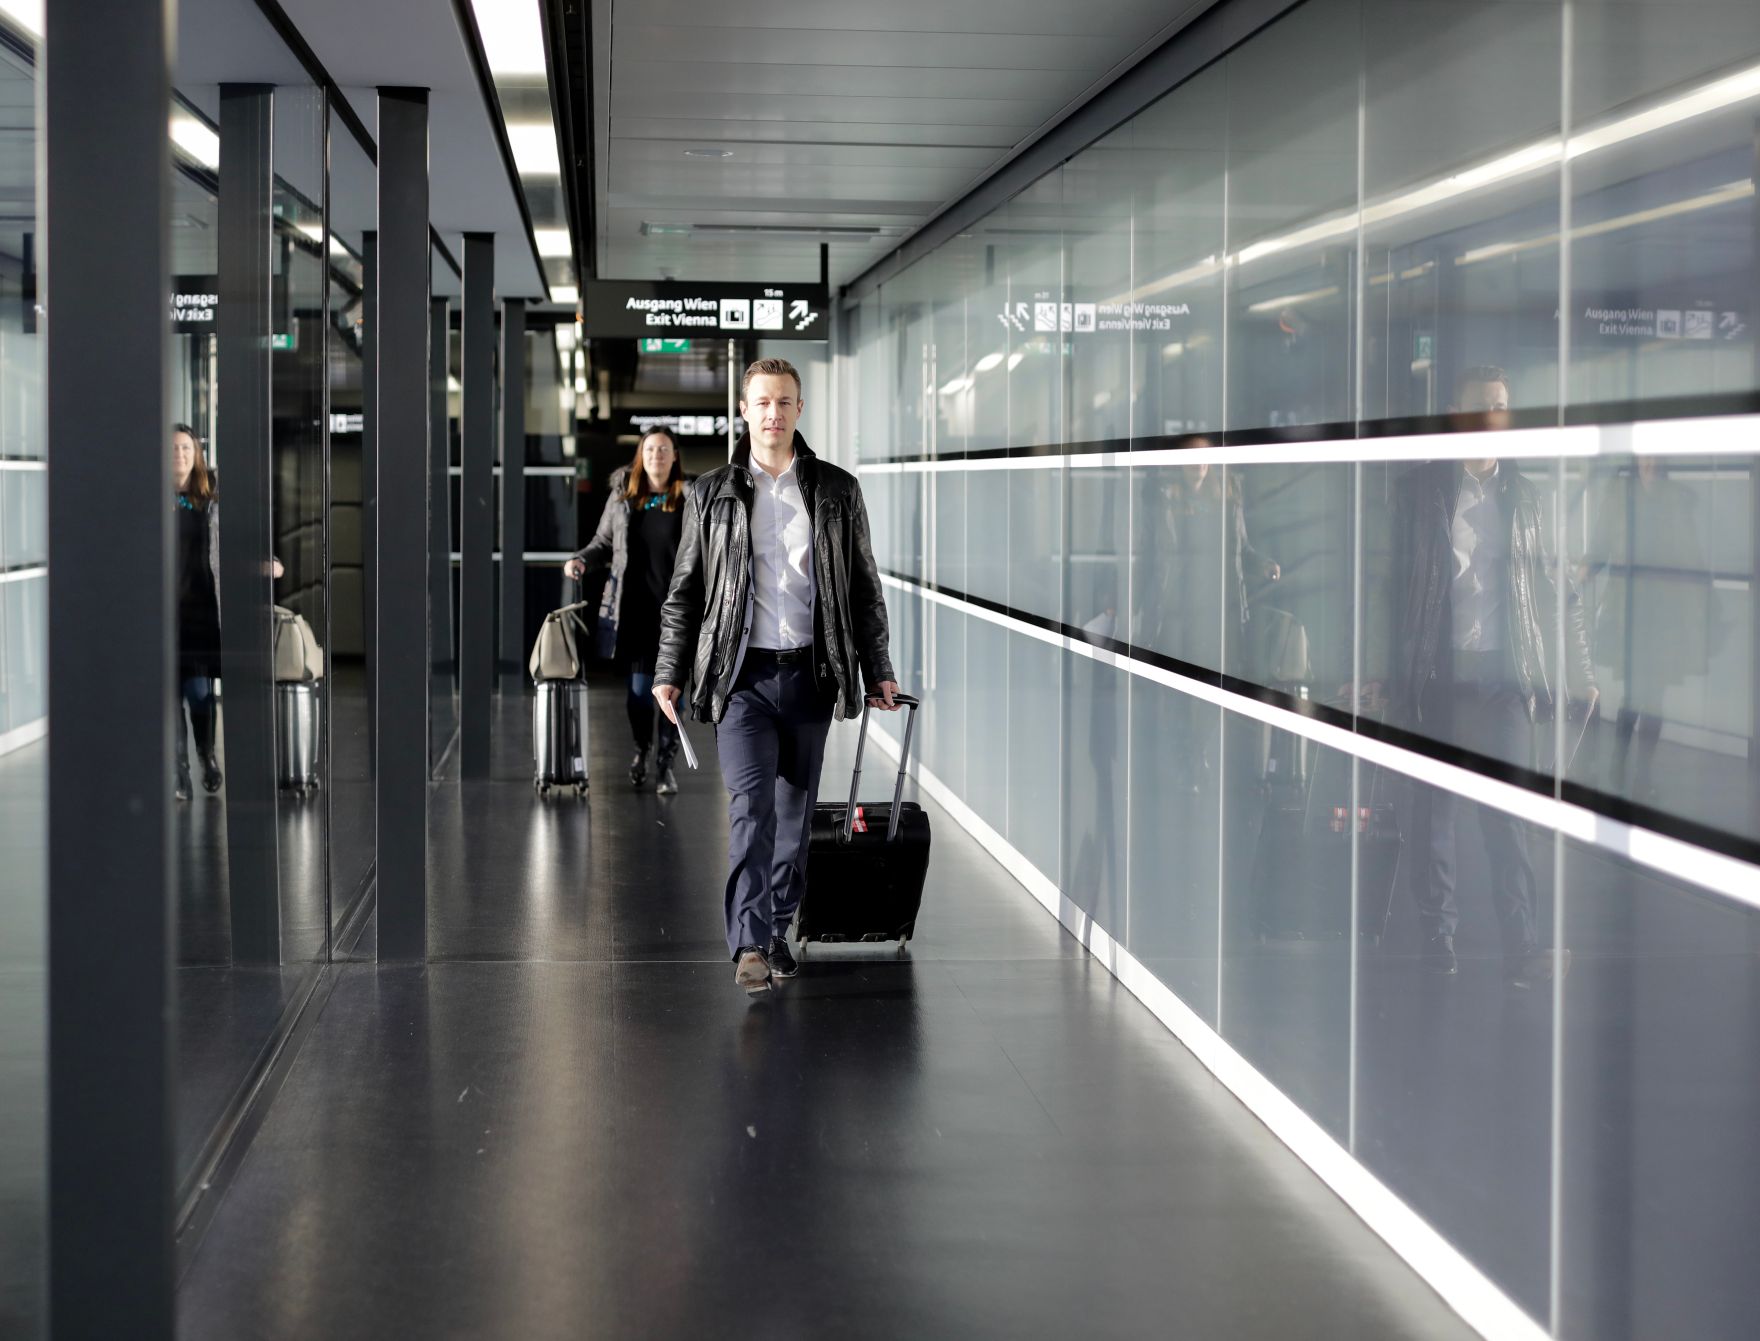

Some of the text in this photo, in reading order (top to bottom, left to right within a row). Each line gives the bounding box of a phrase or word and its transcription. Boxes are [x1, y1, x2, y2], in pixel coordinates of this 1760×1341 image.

[626, 297, 718, 313] Ausgang Wien
[646, 313, 718, 326] Exit Vienna
[1585, 307, 1654, 321] Ausgang Wien
[1599, 323, 1654, 336] Exit Vienna
